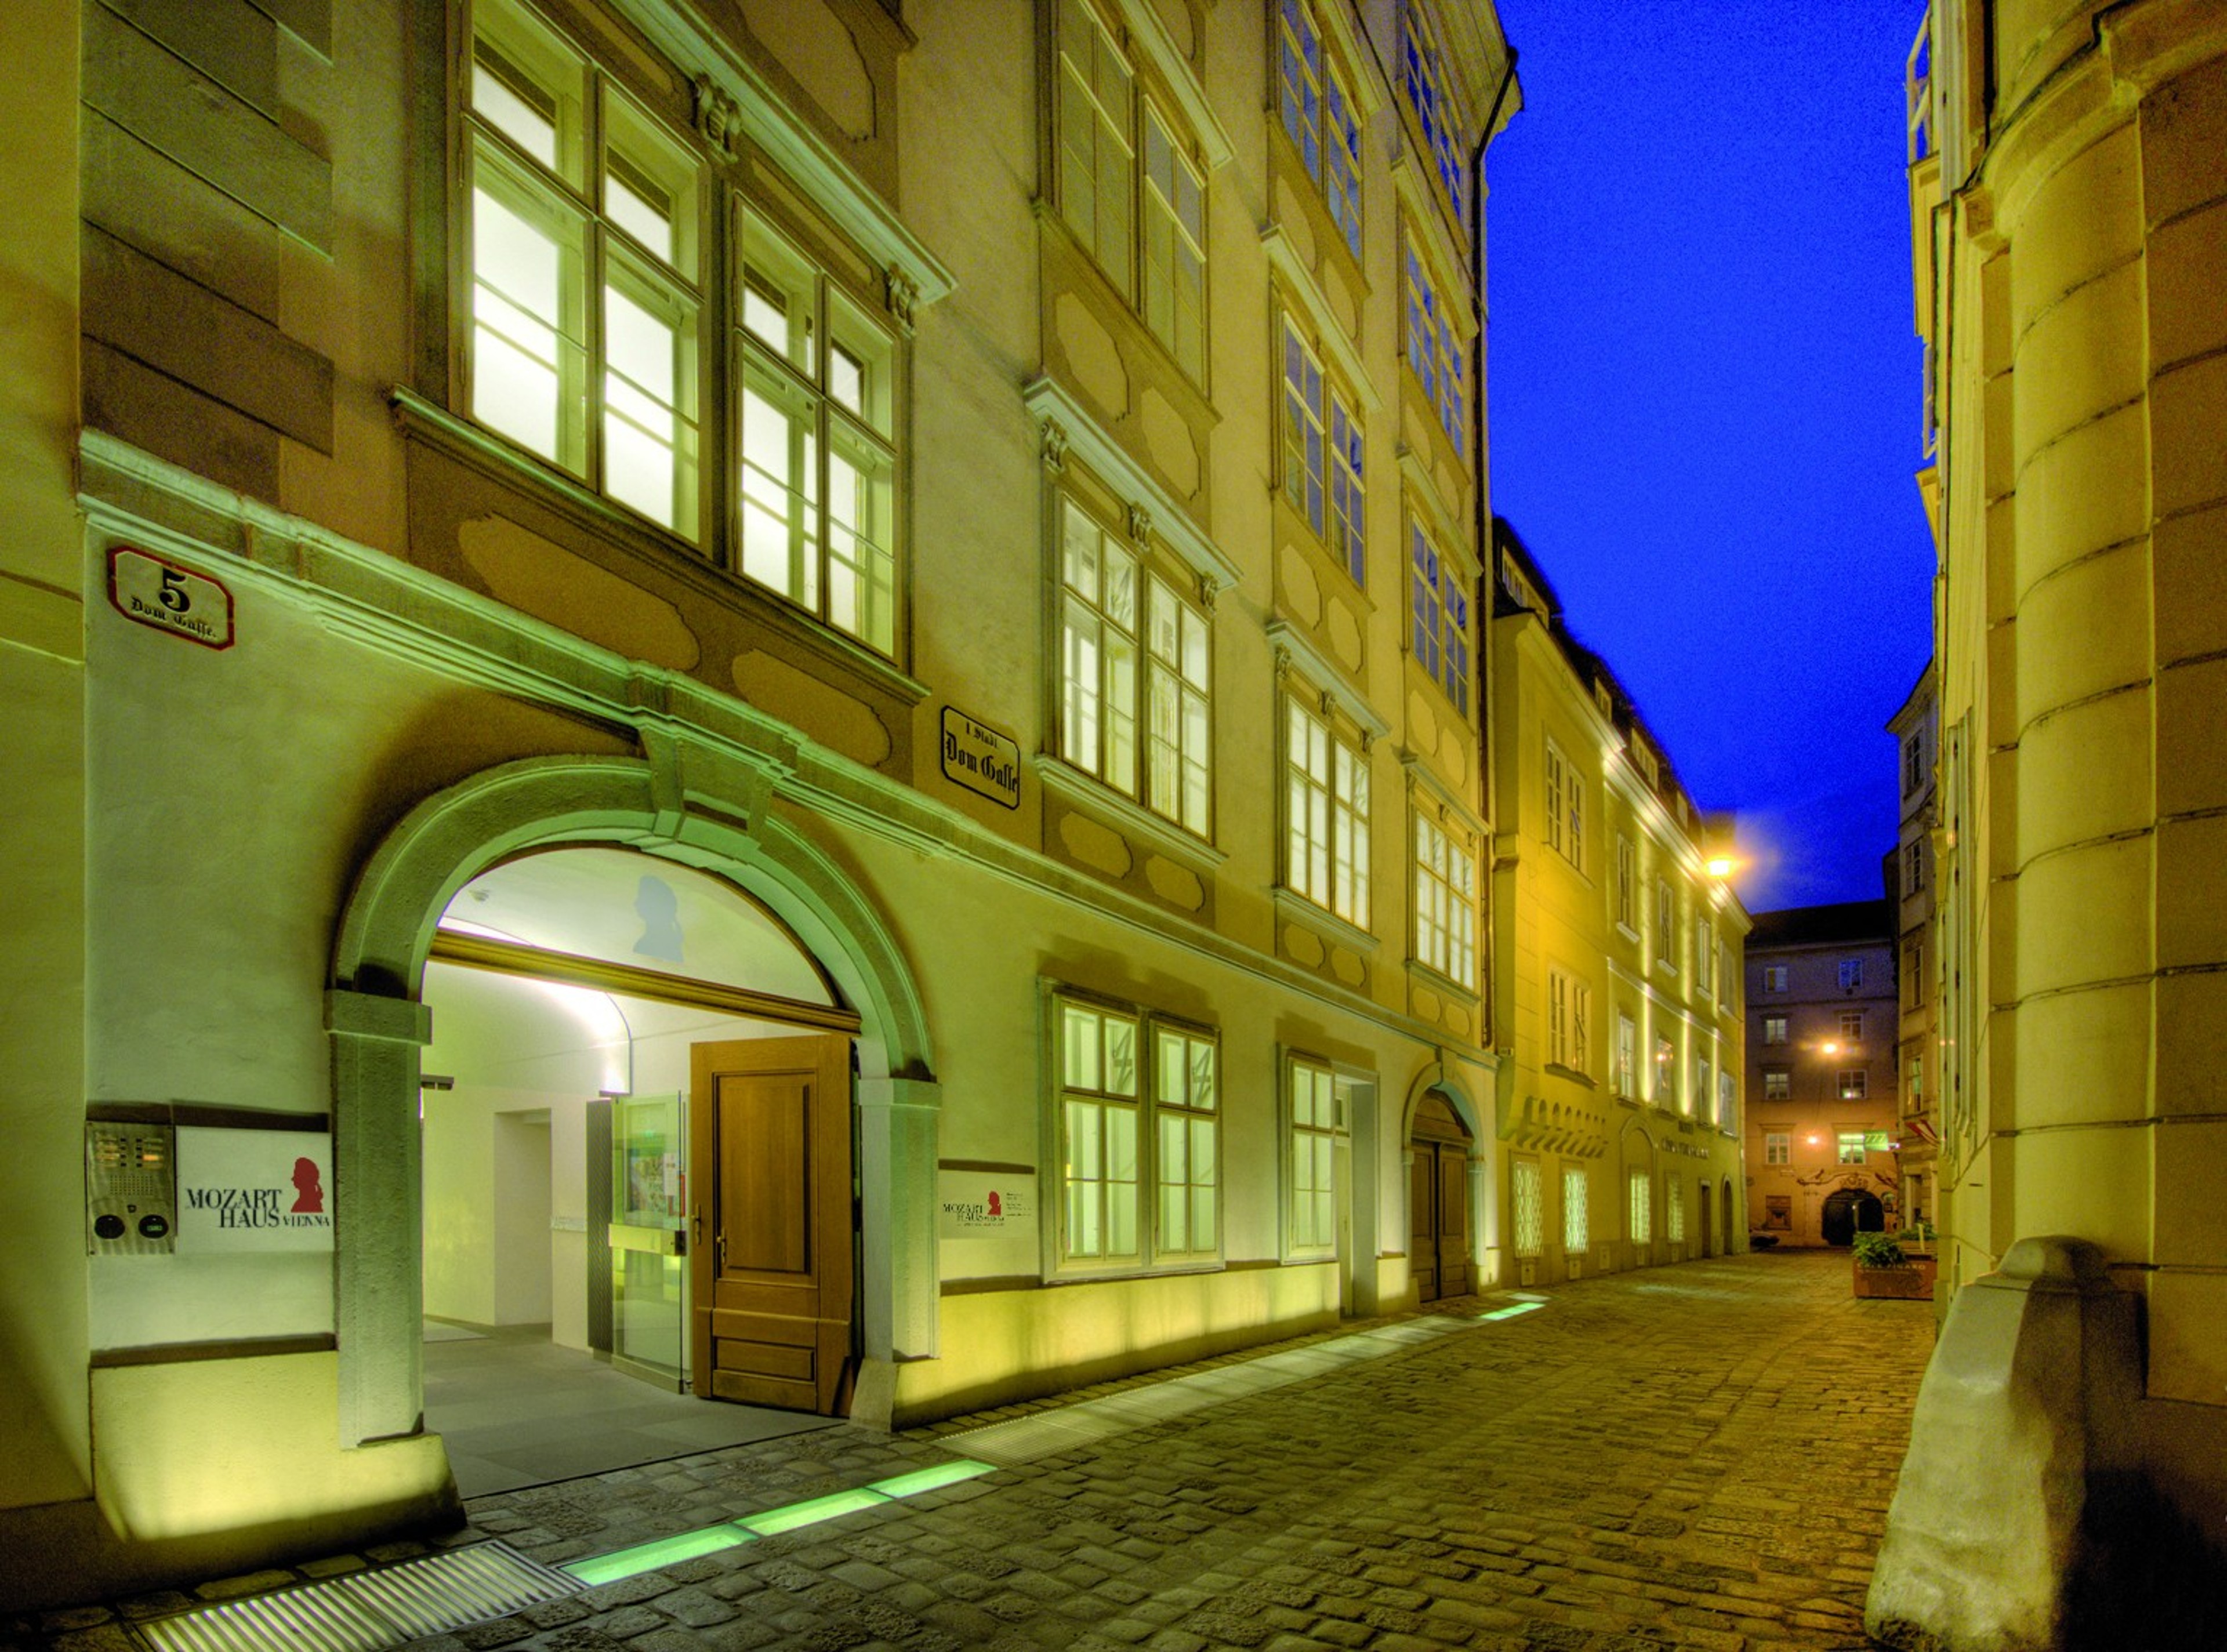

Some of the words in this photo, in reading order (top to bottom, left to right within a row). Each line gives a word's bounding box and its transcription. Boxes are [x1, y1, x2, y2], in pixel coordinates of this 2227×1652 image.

[159, 567, 191, 613] 5
[131, 596, 166, 621] Dom
[946, 731, 978, 774] Dom
[185, 1188, 282, 1210] MOZART
[943, 1203, 983, 1214] MOZART
[219, 1207, 280, 1228] HAUS
[282, 1215, 330, 1227] VIENNA
